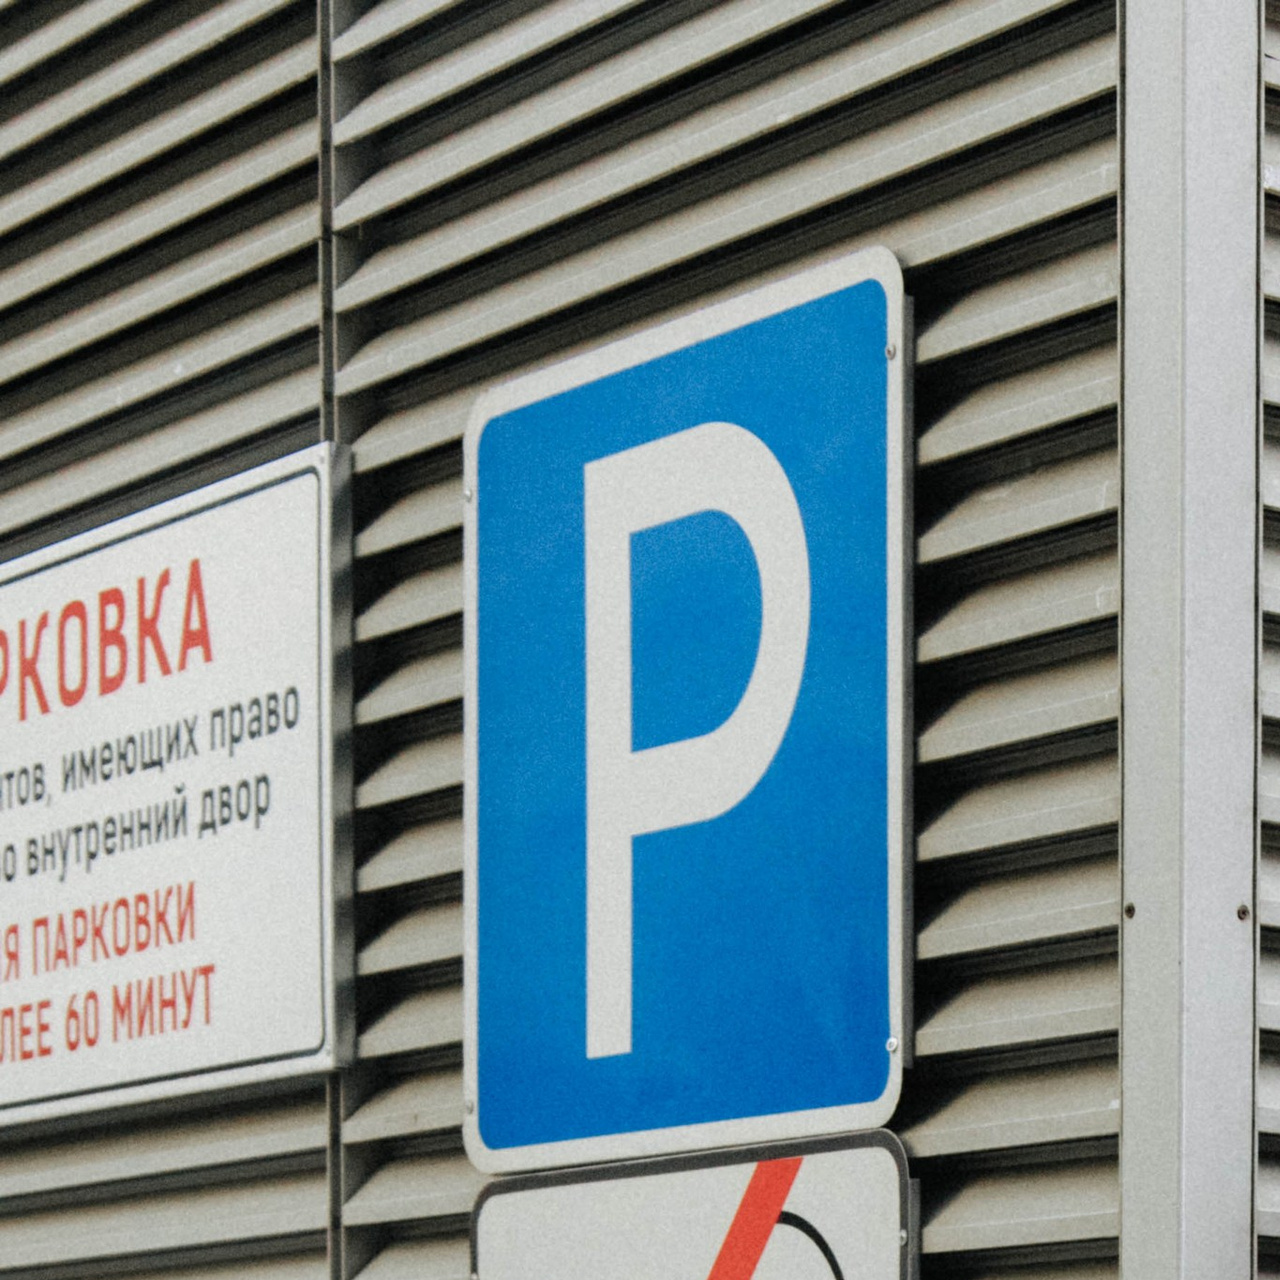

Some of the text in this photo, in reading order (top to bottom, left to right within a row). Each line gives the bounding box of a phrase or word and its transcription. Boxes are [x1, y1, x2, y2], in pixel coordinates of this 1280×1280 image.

[0, 686, 299, 811] тов, имеющих право
[584, 421, 811, 1060] P
[27, 782, 188, 883] внутренний
[198, 773, 270, 839] двор
[33, 881, 196, 976] ПАРКОВКИ
[65, 990, 100, 1052] 60
[112, 963, 216, 1043] МИНУТ
